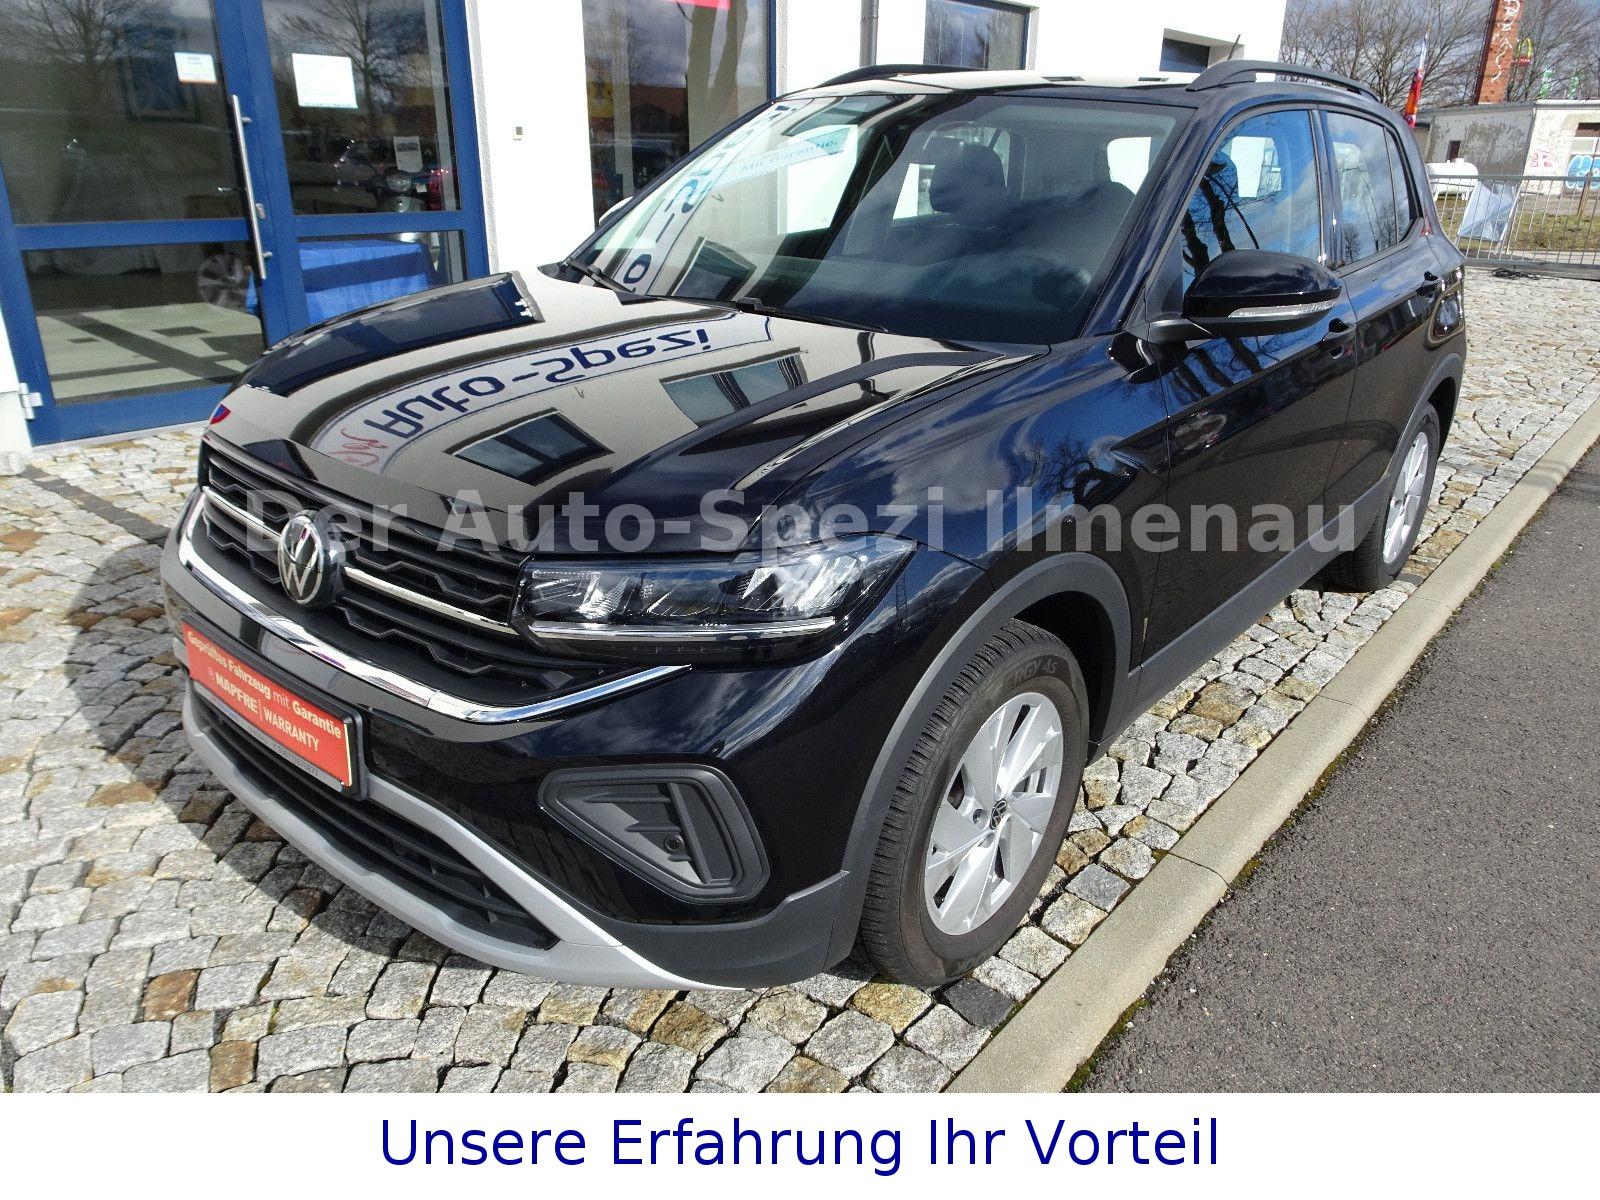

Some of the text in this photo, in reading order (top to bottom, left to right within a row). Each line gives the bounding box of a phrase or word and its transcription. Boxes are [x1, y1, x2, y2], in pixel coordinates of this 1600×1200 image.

[214, 672, 320, 752] MAPFRE WARRANTY
[228, 660, 271, 699] Fahrzeug
[273, 691, 290, 710] mit
[292, 701, 342, 739] Garantie
